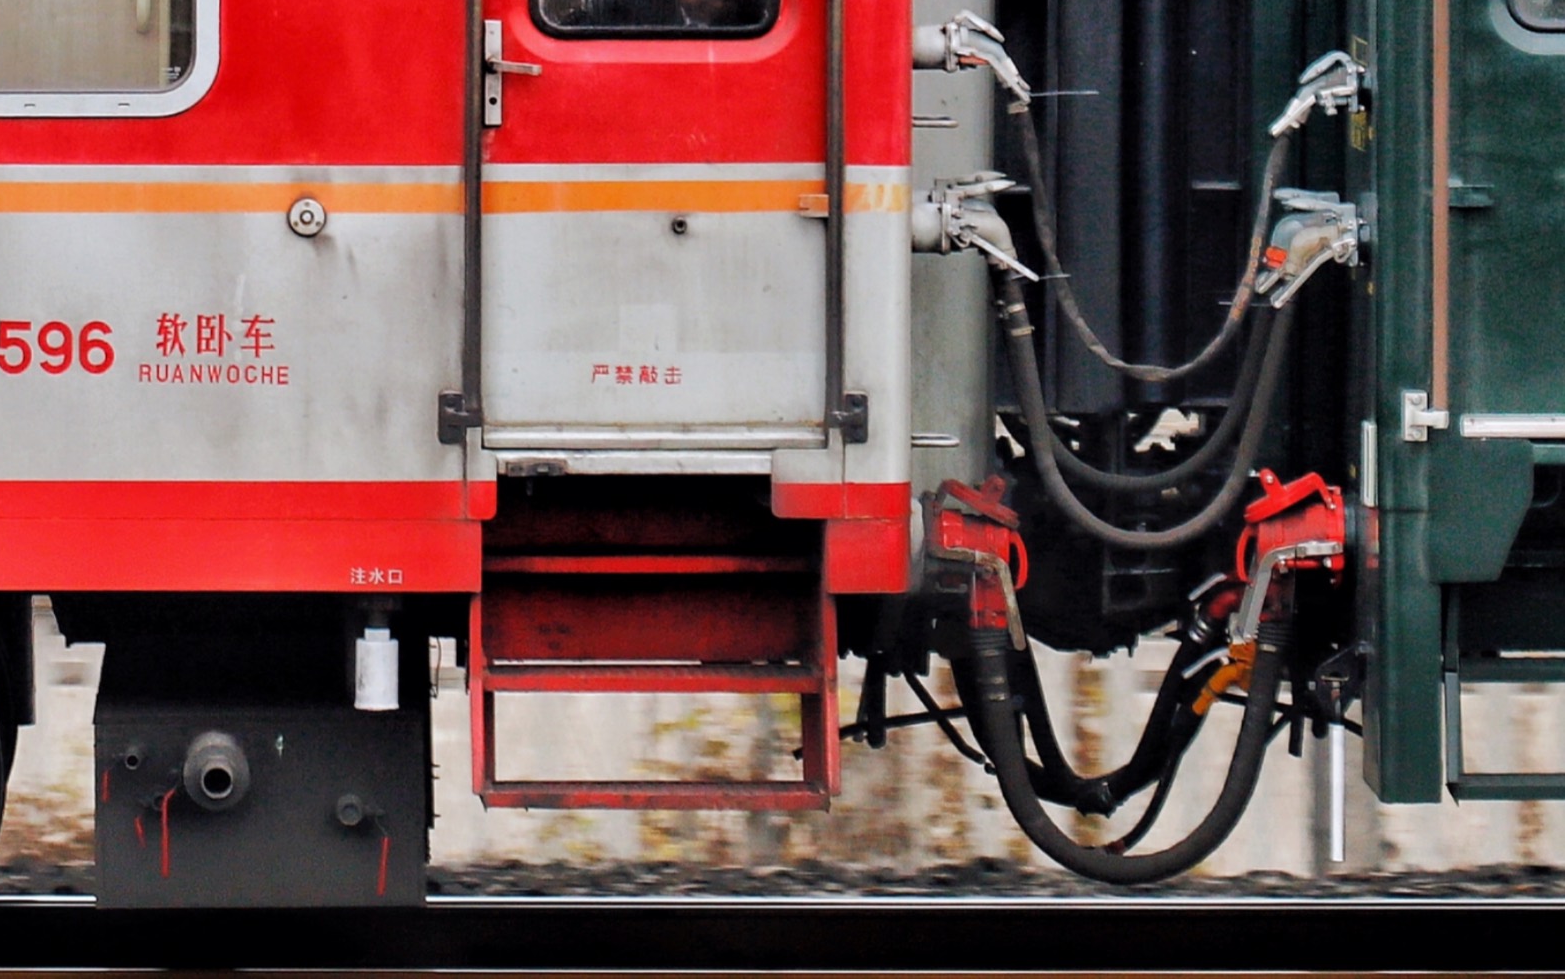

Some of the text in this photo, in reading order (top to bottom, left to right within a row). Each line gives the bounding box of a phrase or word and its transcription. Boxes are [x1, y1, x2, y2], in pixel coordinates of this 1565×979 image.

[155, 312, 275, 359] 软卧车
[138, 364, 289, 385] RUANWOCHE
[591, 364, 683, 385] 严禁敲击
[350, 567, 403, 584] 注水口
